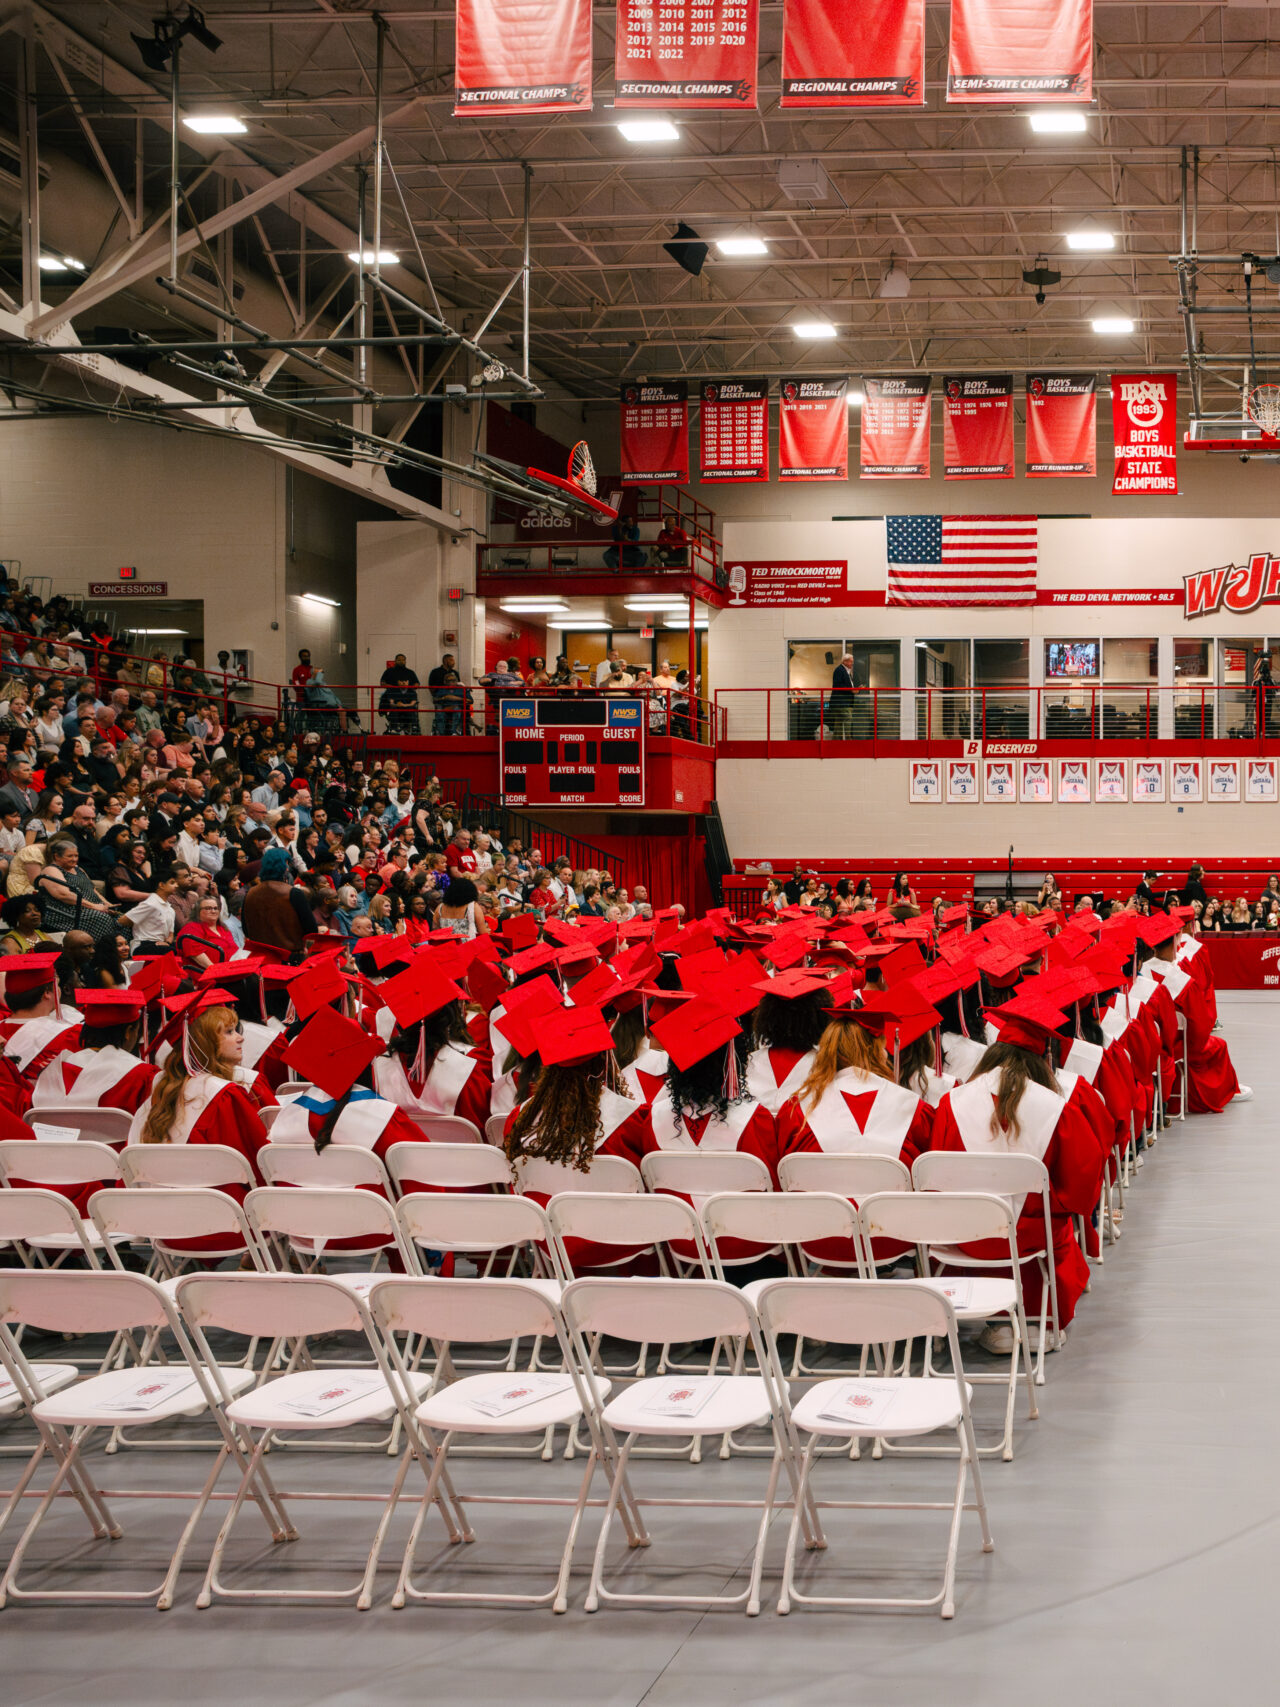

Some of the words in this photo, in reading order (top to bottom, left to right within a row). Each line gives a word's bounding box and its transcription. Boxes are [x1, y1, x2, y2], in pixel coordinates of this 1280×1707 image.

[628, 9, 653, 19] 2009
[659, 9, 685, 19] 2010
[691, 9, 714, 19] 2011
[722, 9, 747, 19] 2012
[628, 22, 653, 32] 2013
[659, 22, 685, 32] 2014
[691, 22, 716, 32] 2015
[722, 21, 747, 31] 2016
[628, 35, 653, 45] 2017
[659, 35, 684, 45] 2018
[690, 35, 715, 45] 2019
[720, 35, 746, 45] 2020
[627, 48, 651, 58] 2021
[659, 48, 684, 58] 2022
[621, 83, 684, 95] SECTIONAL
[685, 83, 733, 95] CHAMPS
[789, 82, 848, 93] REGIONAL
[849, 81, 898, 92] CHAMPS
[953, 79, 1019, 90] SEMI-STATE
[1020, 79, 1069, 89] CHAMPS
[460, 89, 520, 102] SECTIONAL
[521, 87, 567, 99] CHAMPS
[720, 384, 744, 392] BOYS
[800, 383, 824, 391] BOYS
[963, 381, 988, 389] BOYS
[1047, 379, 1072, 387] BOYS
[719, 391, 762, 399] BASKETBALL
[963, 387, 1007, 395] BASKETBALL
[1132, 404, 1157, 415] 1993
[1130, 430, 1159, 443] BOYS
[1115, 445, 1176, 458] BASKETBALL
[1127, 462, 1162, 474] STATE
[1115, 477, 1175, 490] CHAMPIONS
[520, 513, 572, 529] adidas
[752, 568, 768, 576] TED
[770, 567, 843, 576] THROCKMORTON
[93, 585, 162, 594] CONCESSIONS
[1053, 594, 1068, 602] THE
[506, 708, 531, 716] NWSB
[612, 708, 637, 716] NWSB
[515, 728, 545, 739] HOME
[603, 728, 637, 739] GUEST
[967, 742, 978, 755] B
[986, 743, 1037, 754] RESERVED
[961, 785, 966, 794] 3
[1183, 784, 1189, 793] 8
[1221, 783, 1227, 792] 7
[1264, 975, 1279, 985] HIGH
